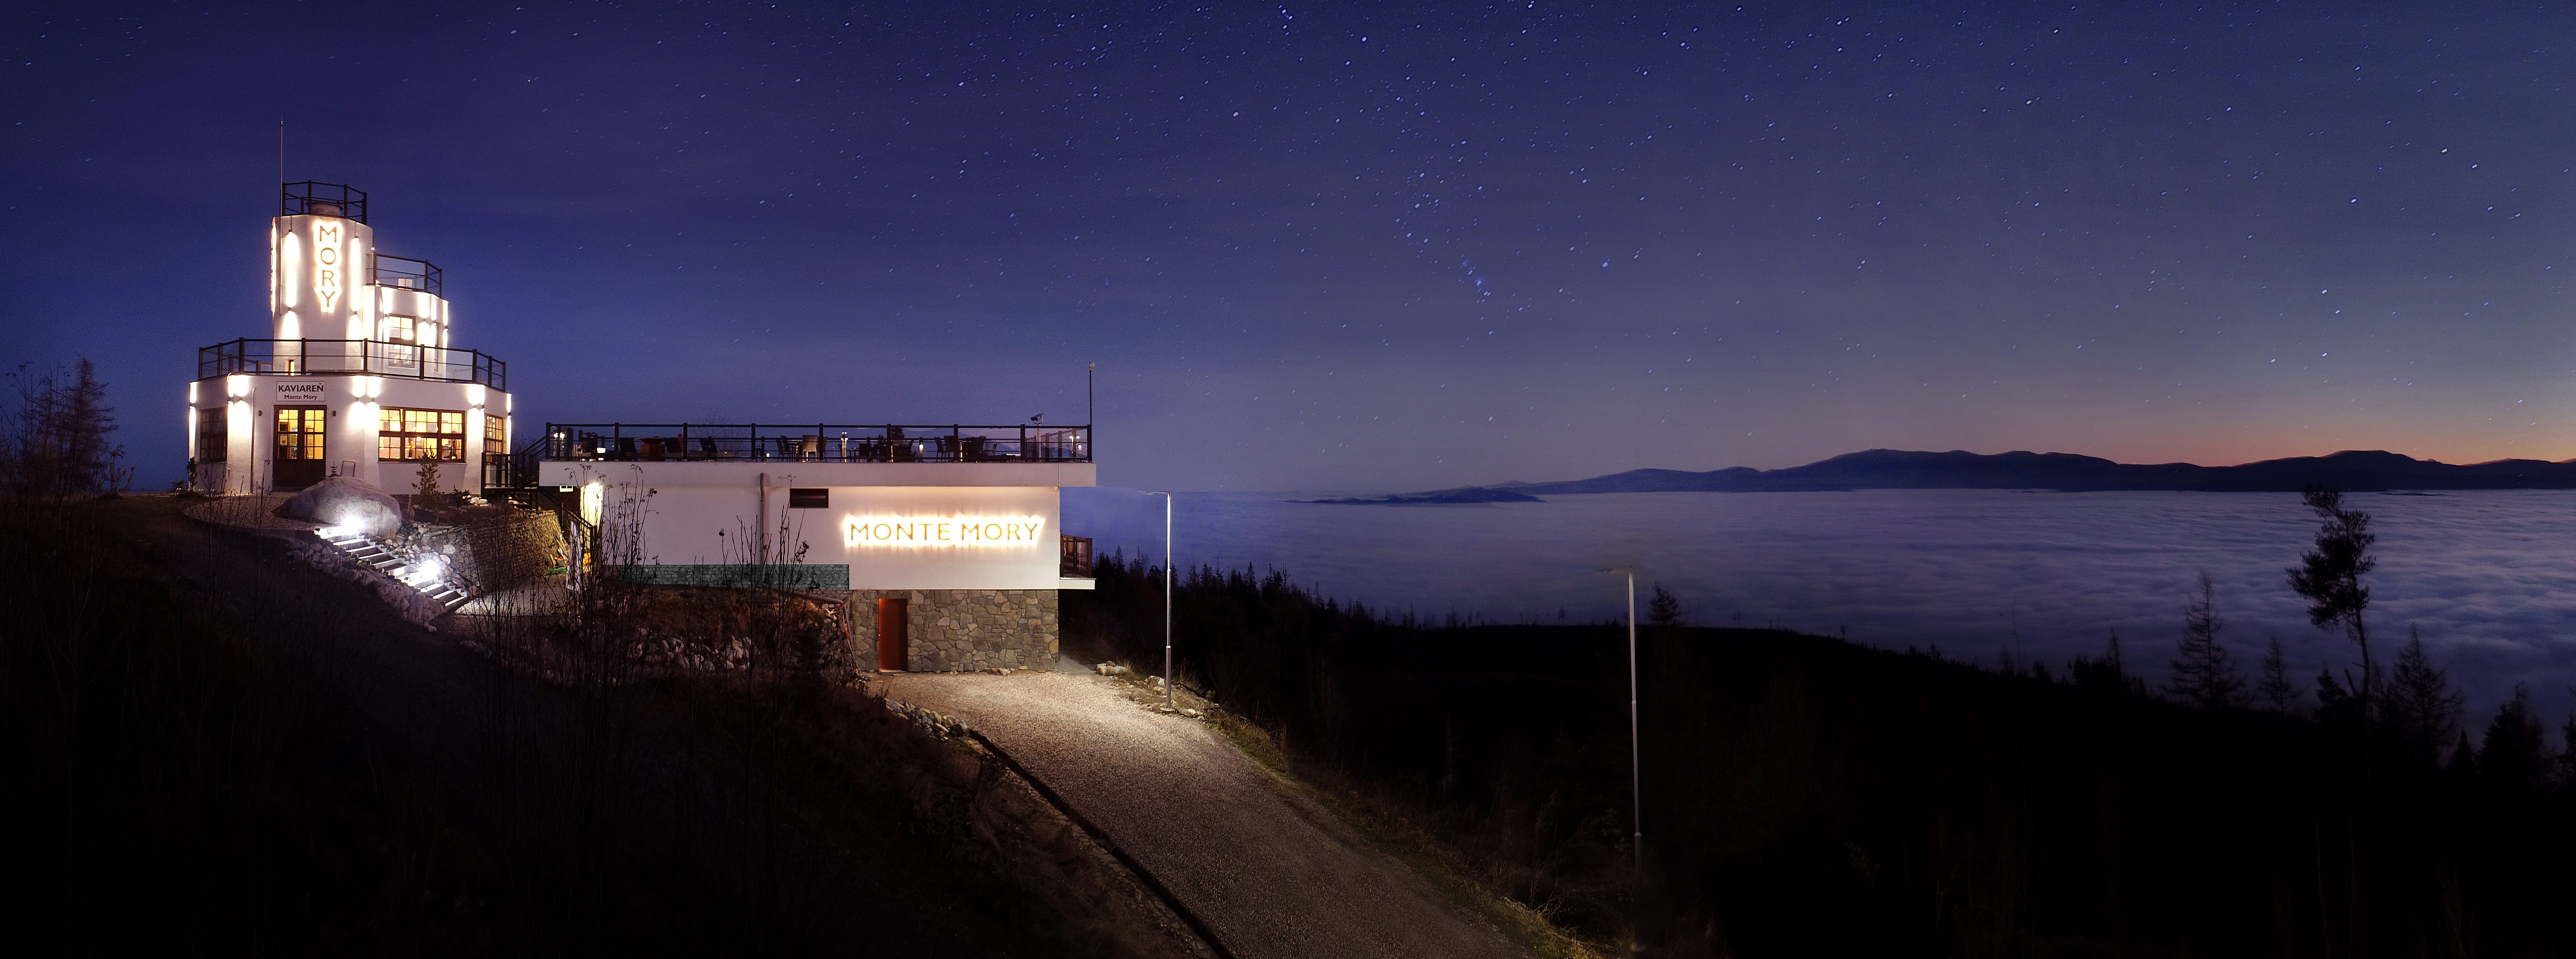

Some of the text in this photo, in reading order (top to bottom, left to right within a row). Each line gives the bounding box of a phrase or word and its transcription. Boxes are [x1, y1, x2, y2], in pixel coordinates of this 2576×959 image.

[319, 226, 337, 307] MORY
[278, 383, 323, 392] KAVIAREŇ
[851, 523, 1038, 540] MONTE MORY
